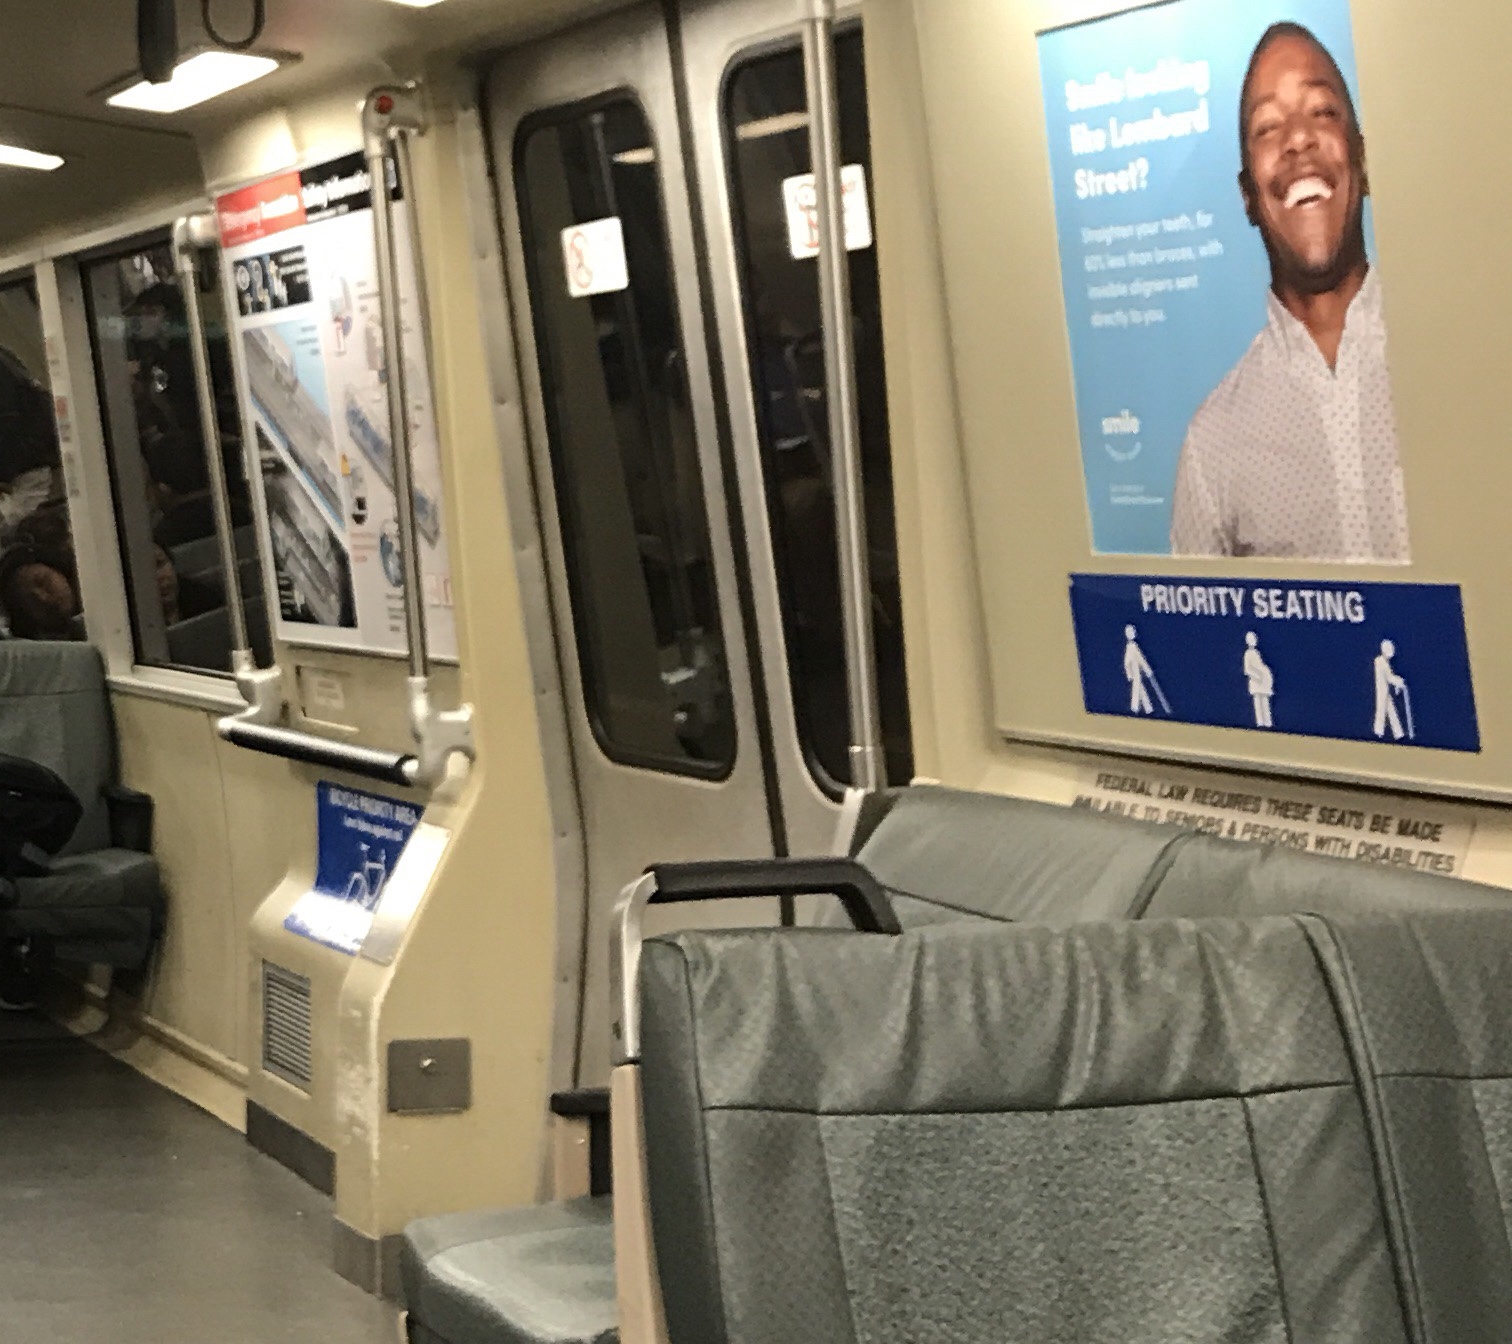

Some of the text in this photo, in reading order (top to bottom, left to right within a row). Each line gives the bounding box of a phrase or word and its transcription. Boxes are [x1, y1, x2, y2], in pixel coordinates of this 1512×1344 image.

[1070, 97, 1209, 155] like Lombard
[1075, 157, 1149, 199] Street?
[1141, 584, 1365, 623] PRIORITY SEATING
[1096, 773, 1444, 842] FEDERAL LAW REQUIRES THESE SEATS BE MADE
[1242, 821, 1309, 849] PERSONS
[1315, 834, 1353, 853] WITH
[1357, 840, 1456, 874] DISABILITIES
